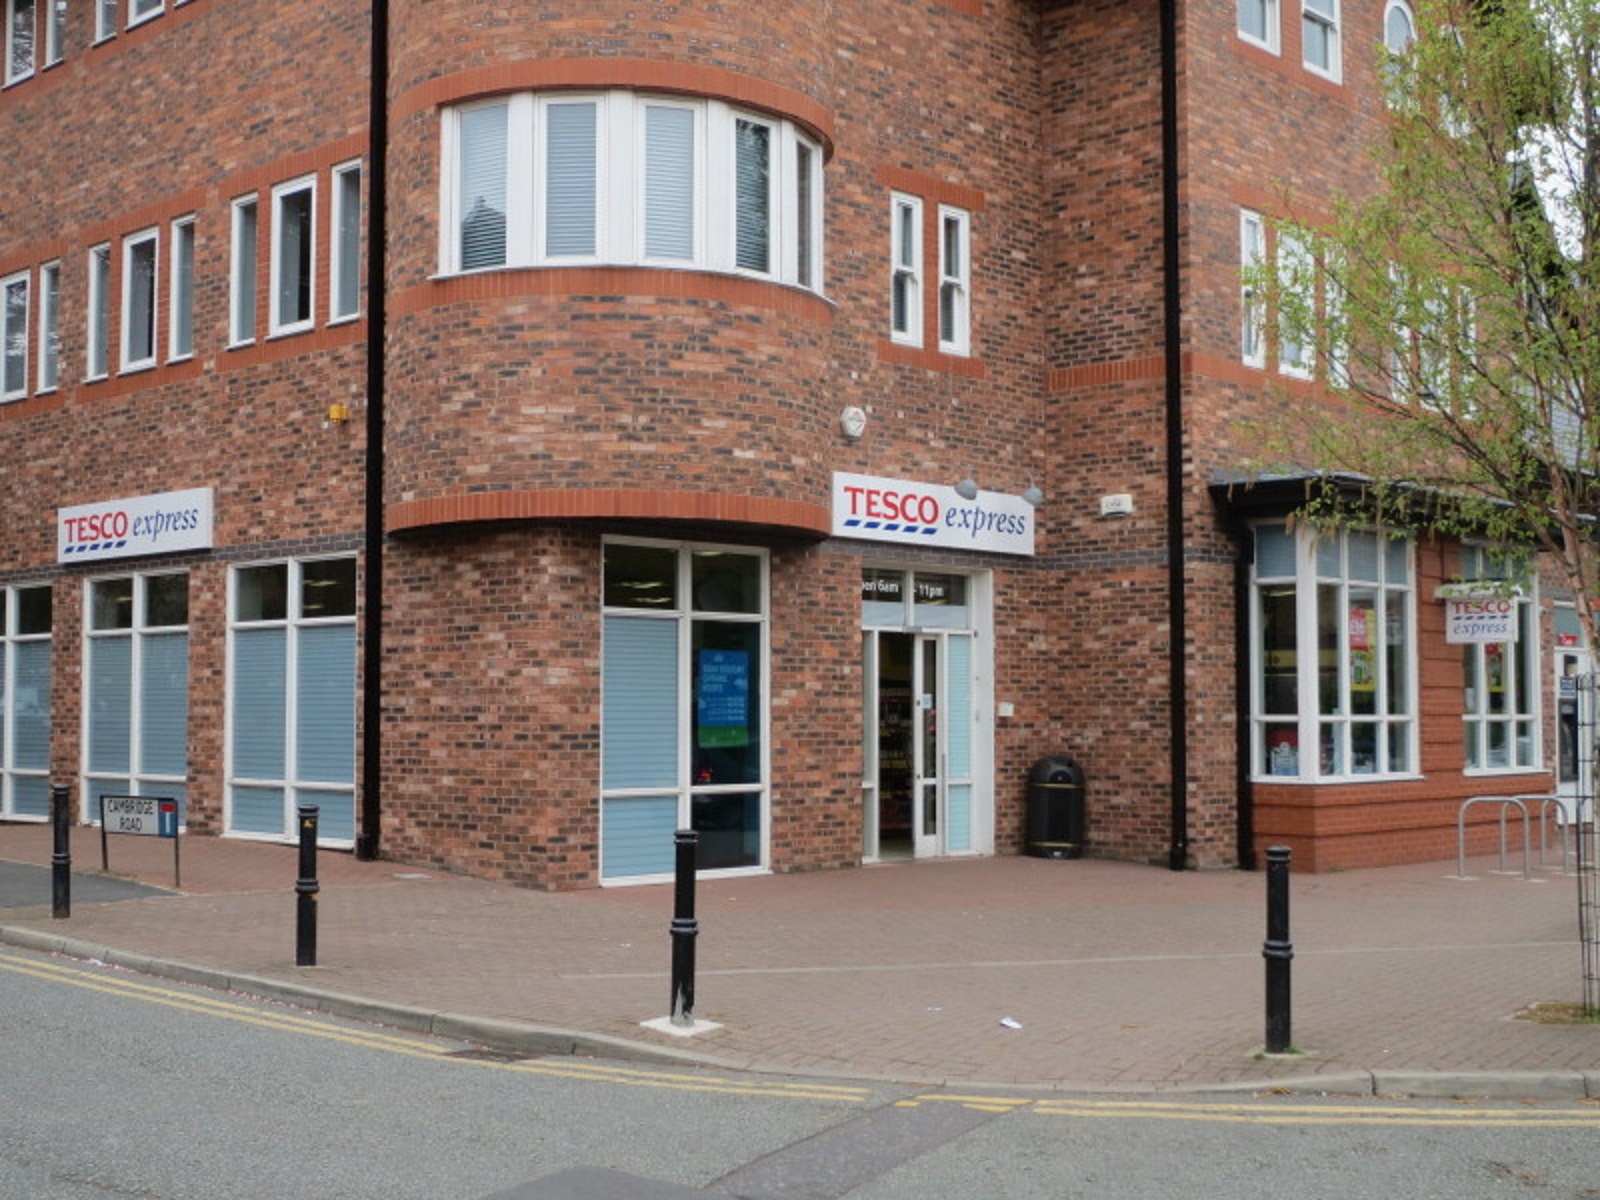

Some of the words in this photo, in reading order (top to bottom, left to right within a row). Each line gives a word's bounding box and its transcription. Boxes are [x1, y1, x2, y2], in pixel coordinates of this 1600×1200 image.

[844, 486, 939, 525] TESCO
[945, 505, 1025, 538] express
[64, 511, 128, 542] TESCO
[133, 508, 199, 542] express
[878, 580, 899, 593] 6am
[919, 584, 945, 598] 11pm
[1451, 600, 1511, 614] TESCO
[1453, 622, 1508, 636] express
[108, 799, 154, 815] CAMBRIDGE
[120, 817, 143, 832] ROAD
